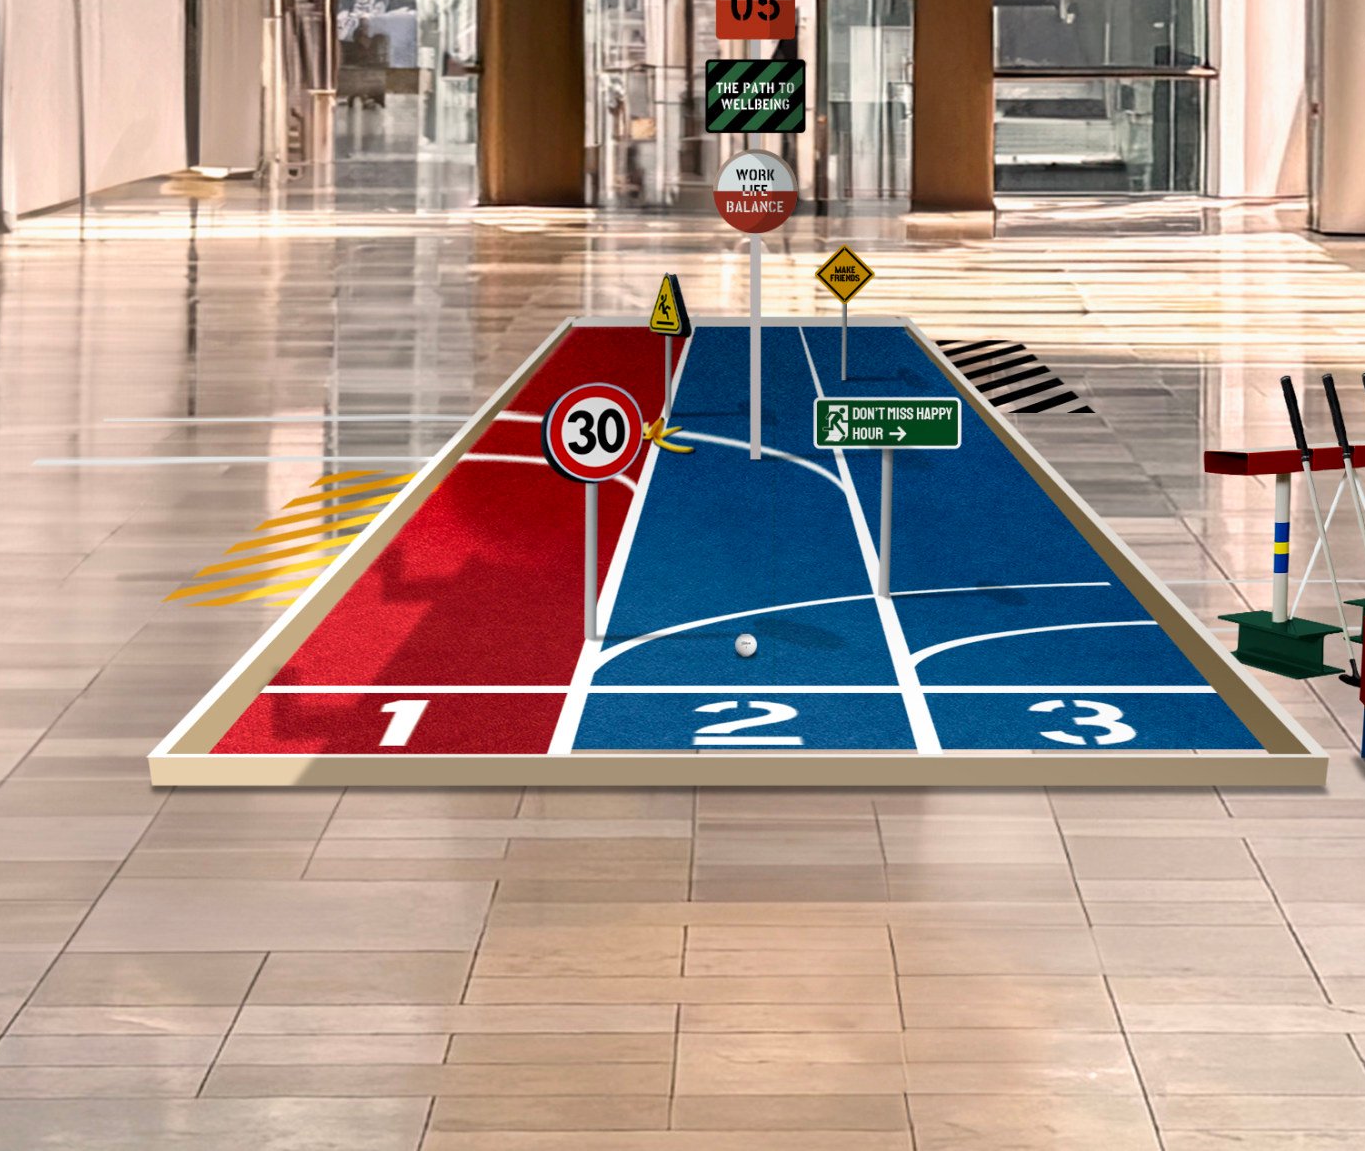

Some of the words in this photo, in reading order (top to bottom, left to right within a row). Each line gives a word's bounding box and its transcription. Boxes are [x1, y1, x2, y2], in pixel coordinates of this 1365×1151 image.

[716, 82, 739, 94] THE
[743, 82, 775, 94] PATH
[779, 82, 795, 94] TO
[721, 98, 790, 111] WELLBEING
[736, 168, 775, 181] WORK
[742, 184, 768, 197] LIFE
[726, 200, 784, 213] BALANCE
[835, 266, 856, 274] MAKE
[829, 274, 861, 282] FRIENDS
[852, 407, 885, 420] DON'T
[887, 407, 914, 420] MISS
[916, 407, 953, 420] HAPPY
[567, 408, 626, 455] 30
[852, 427, 884, 440] HOUR
[379, 699, 431, 747] 1
[693, 701, 804, 745] 2
[1027, 699, 1138, 746] 3
